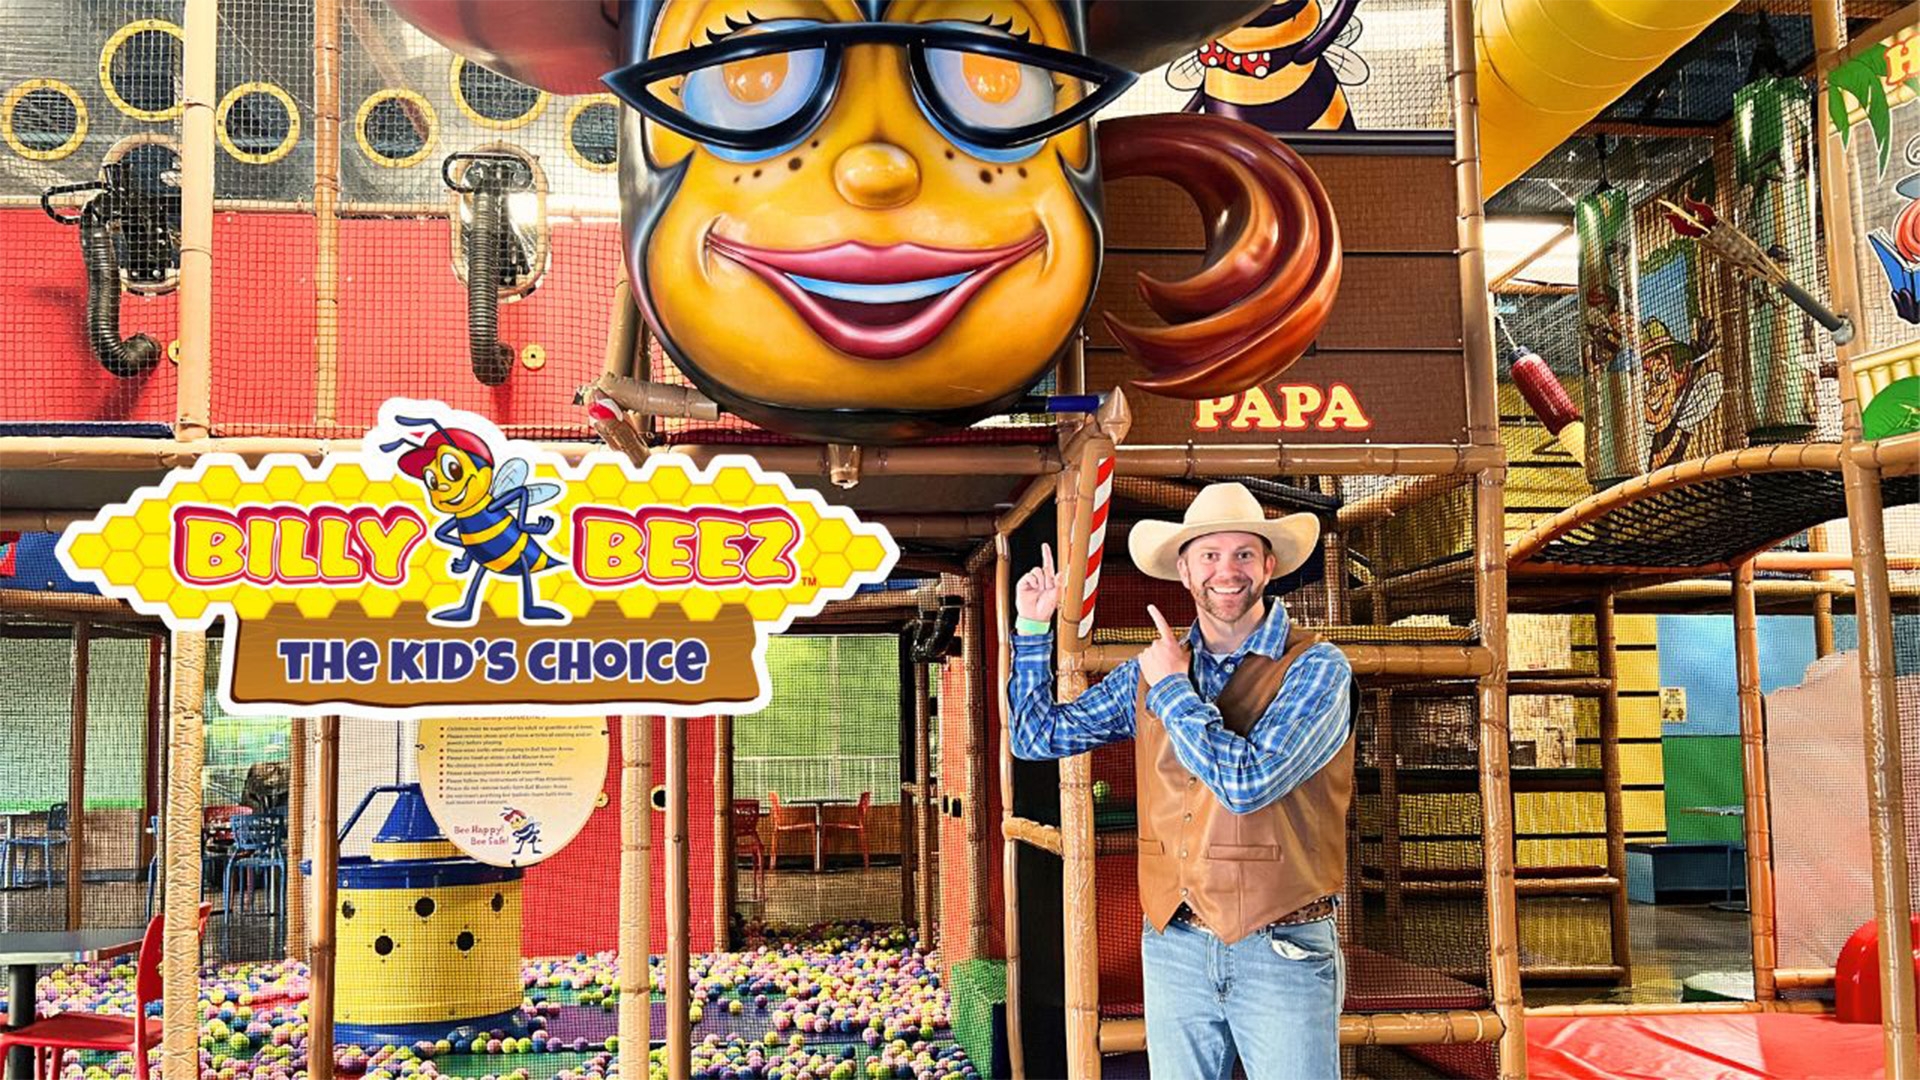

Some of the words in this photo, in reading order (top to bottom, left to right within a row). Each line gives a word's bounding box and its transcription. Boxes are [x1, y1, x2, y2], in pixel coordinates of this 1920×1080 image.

[1191, 382, 1371, 431] PAPA
[454, 826, 470, 834] Bee
[471, 837, 486, 845] Bee
